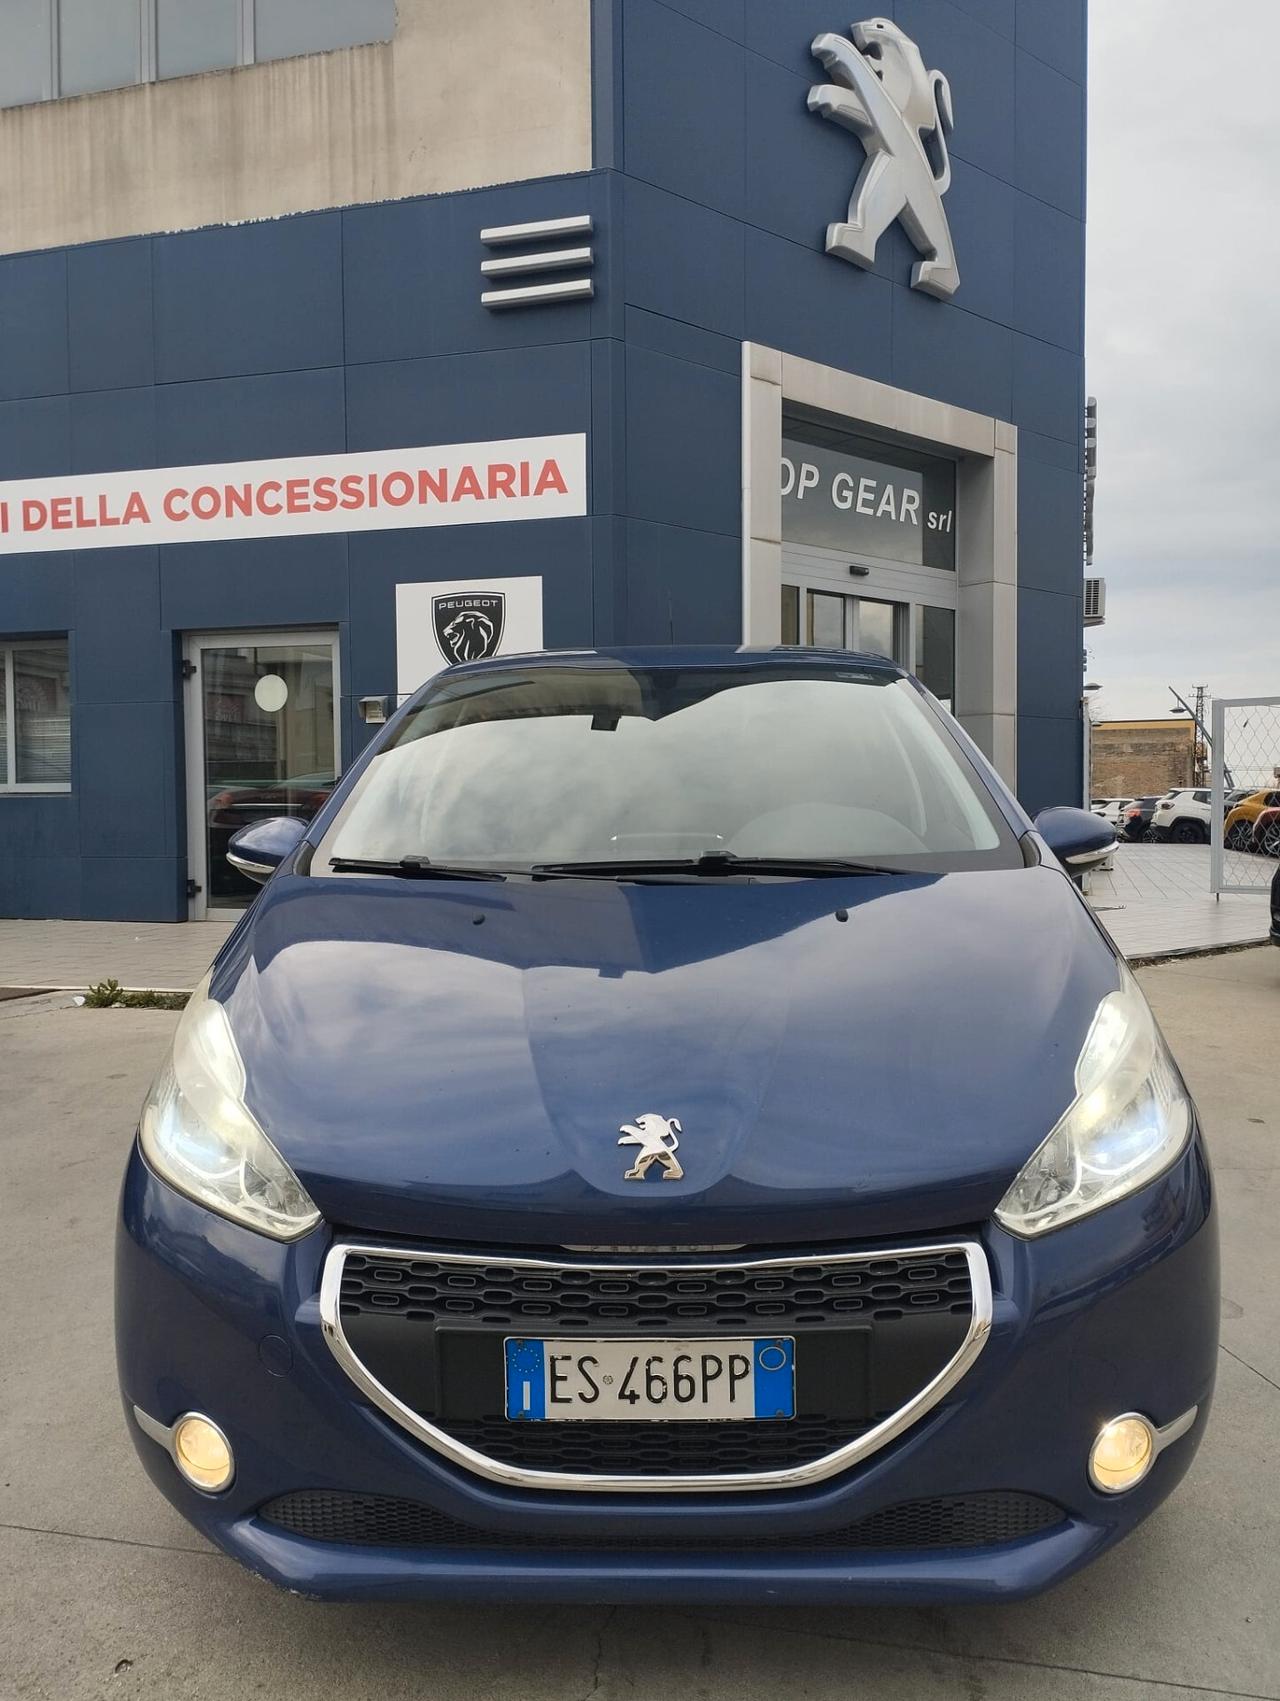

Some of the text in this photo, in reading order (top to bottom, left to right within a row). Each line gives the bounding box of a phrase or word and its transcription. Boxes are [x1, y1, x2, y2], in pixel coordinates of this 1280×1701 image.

[22, 491, 152, 532] DELLA
[163, 459, 569, 522] CONCESSIONARIA
[831, 472, 920, 525] GEAR
[927, 510, 952, 533] srl
[438, 599, 498, 610] PEUGEOT
[549, 1354, 752, 1405] ES 466PP
